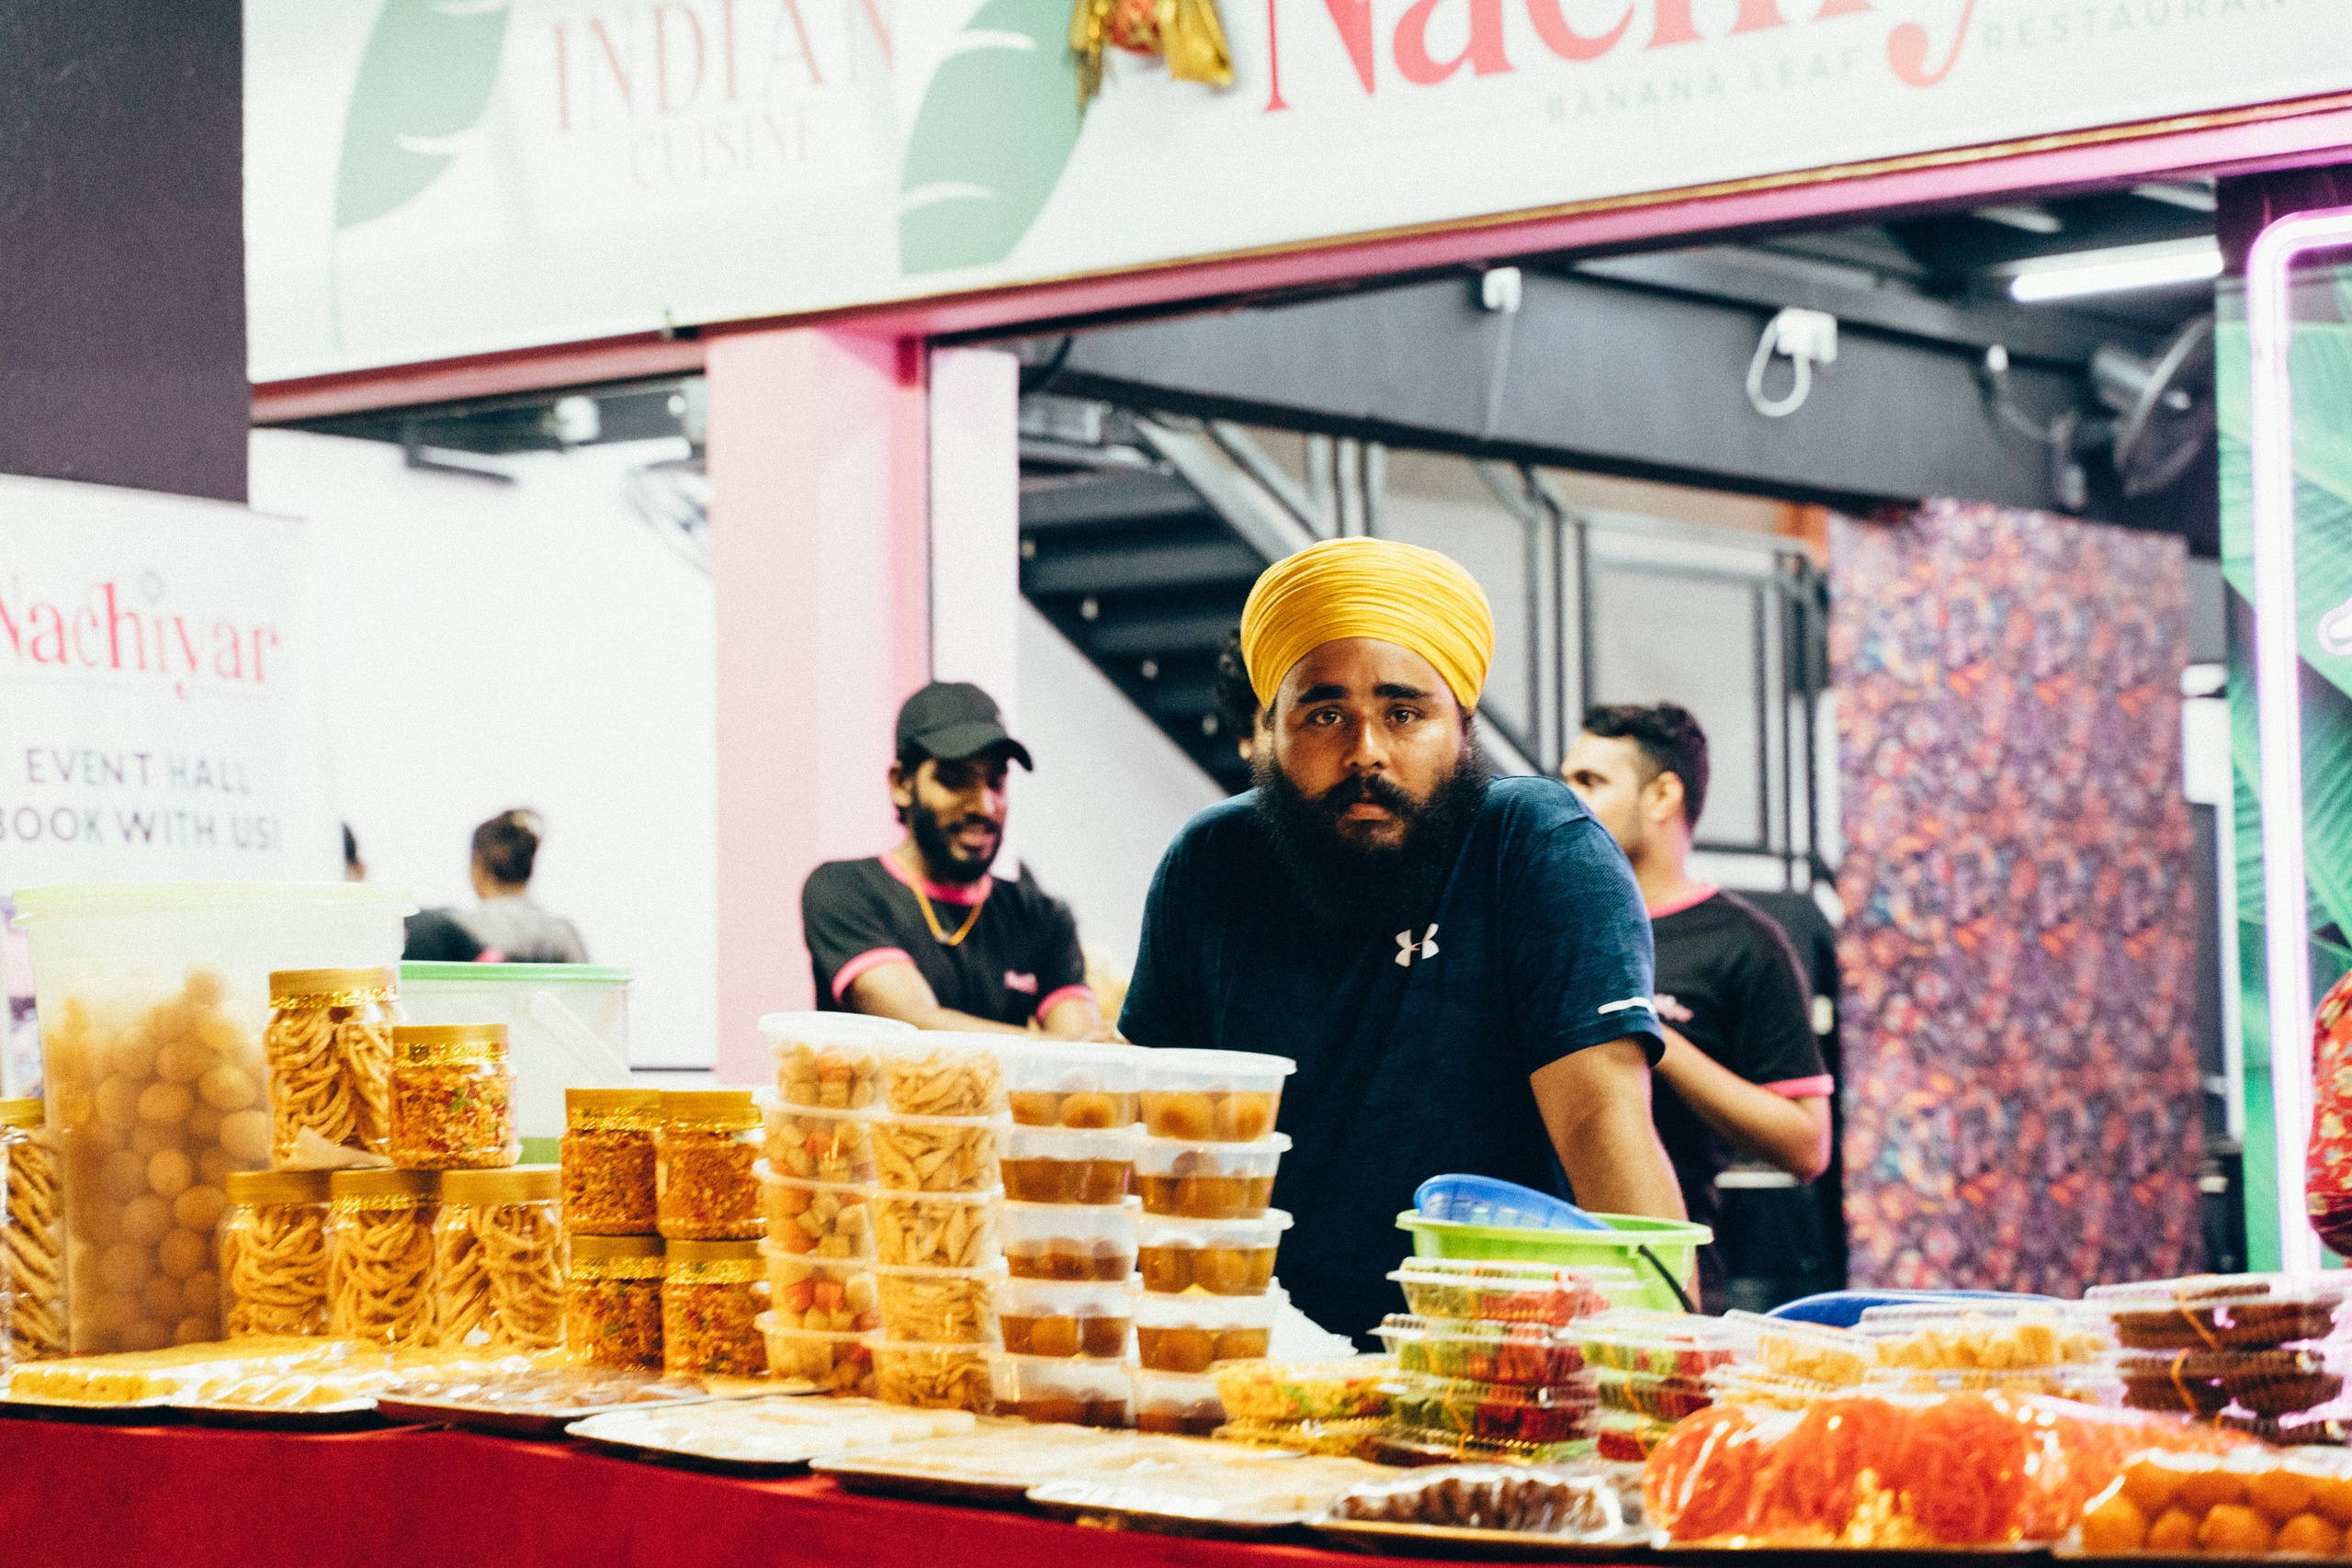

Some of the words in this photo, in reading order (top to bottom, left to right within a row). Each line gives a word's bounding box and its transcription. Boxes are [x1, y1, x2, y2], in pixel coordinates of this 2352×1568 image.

[554, 0, 895, 131] INDIAN
[1544, 70, 1725, 125] BANANA
[1749, 46, 1859, 93] LEAF
[628, 104, 817, 191] CUISINE
[26, 748, 152, 785] EVENT
[167, 755, 252, 795] HALL
[116, 810, 217, 846] WITH
